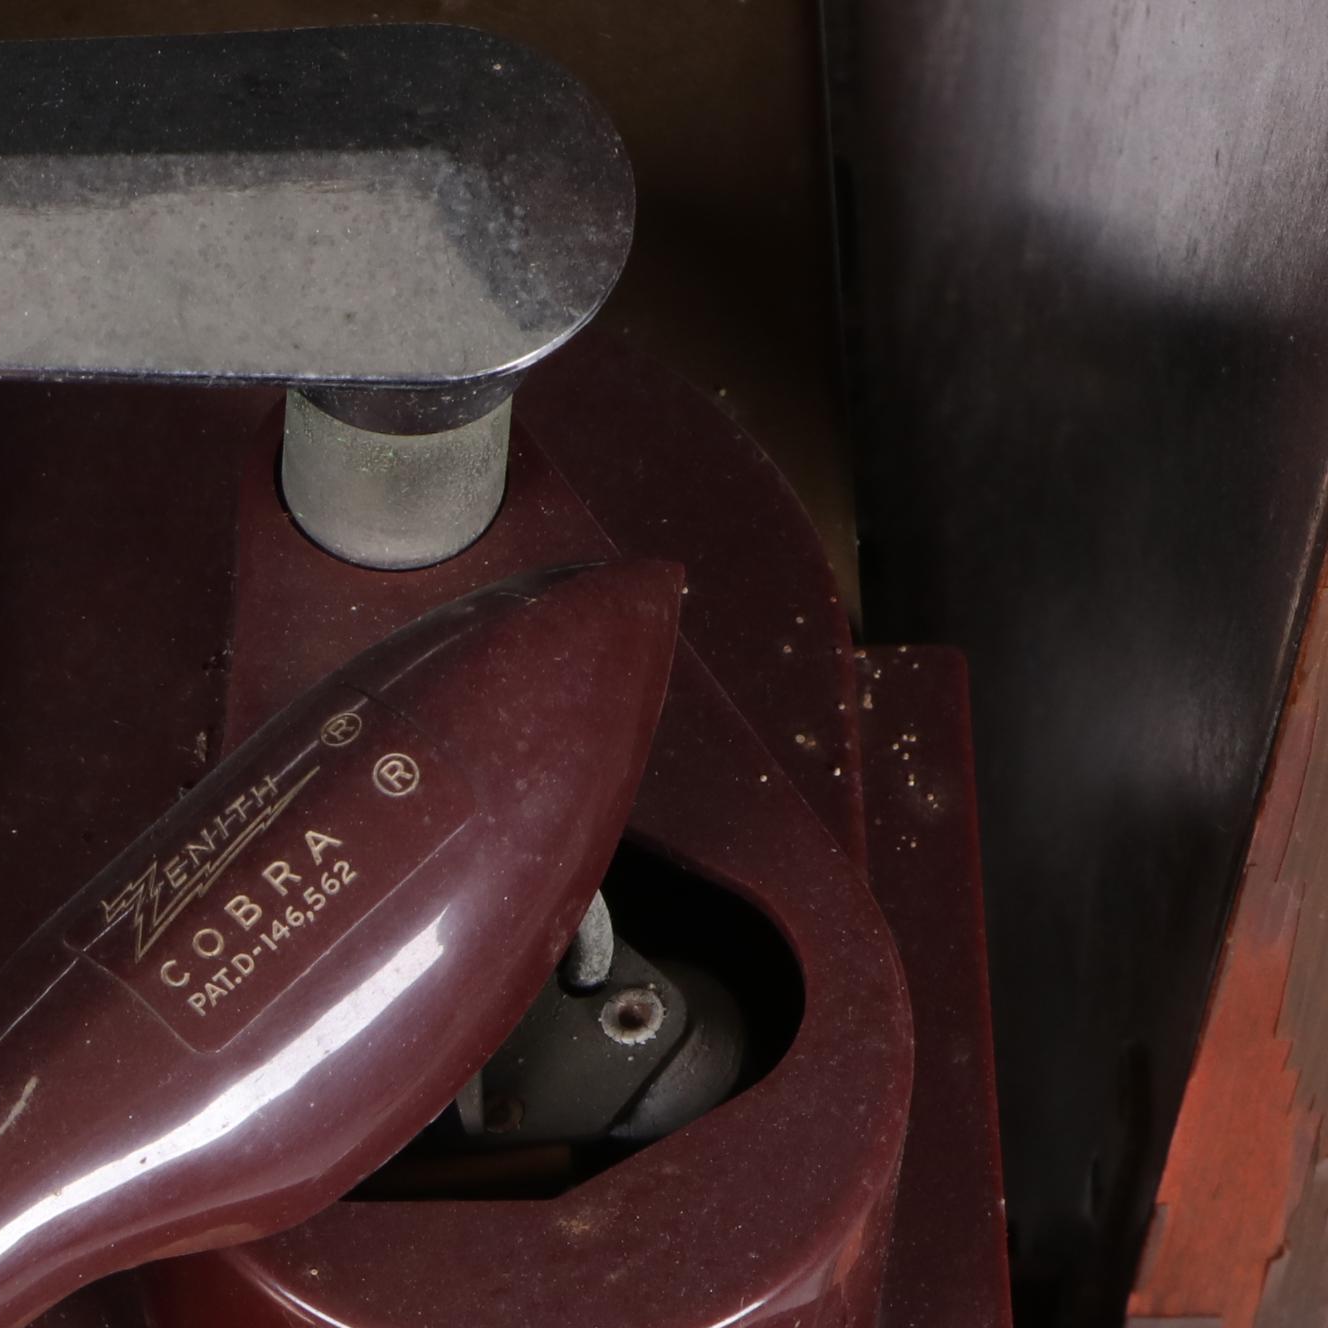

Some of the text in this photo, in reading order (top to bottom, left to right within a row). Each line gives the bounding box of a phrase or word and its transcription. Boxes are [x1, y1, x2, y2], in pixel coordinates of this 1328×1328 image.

[101, 767, 320, 965] ZENITH
[160, 830, 343, 988] COBRA
[187, 860, 358, 1017] PAT.D-146,562
